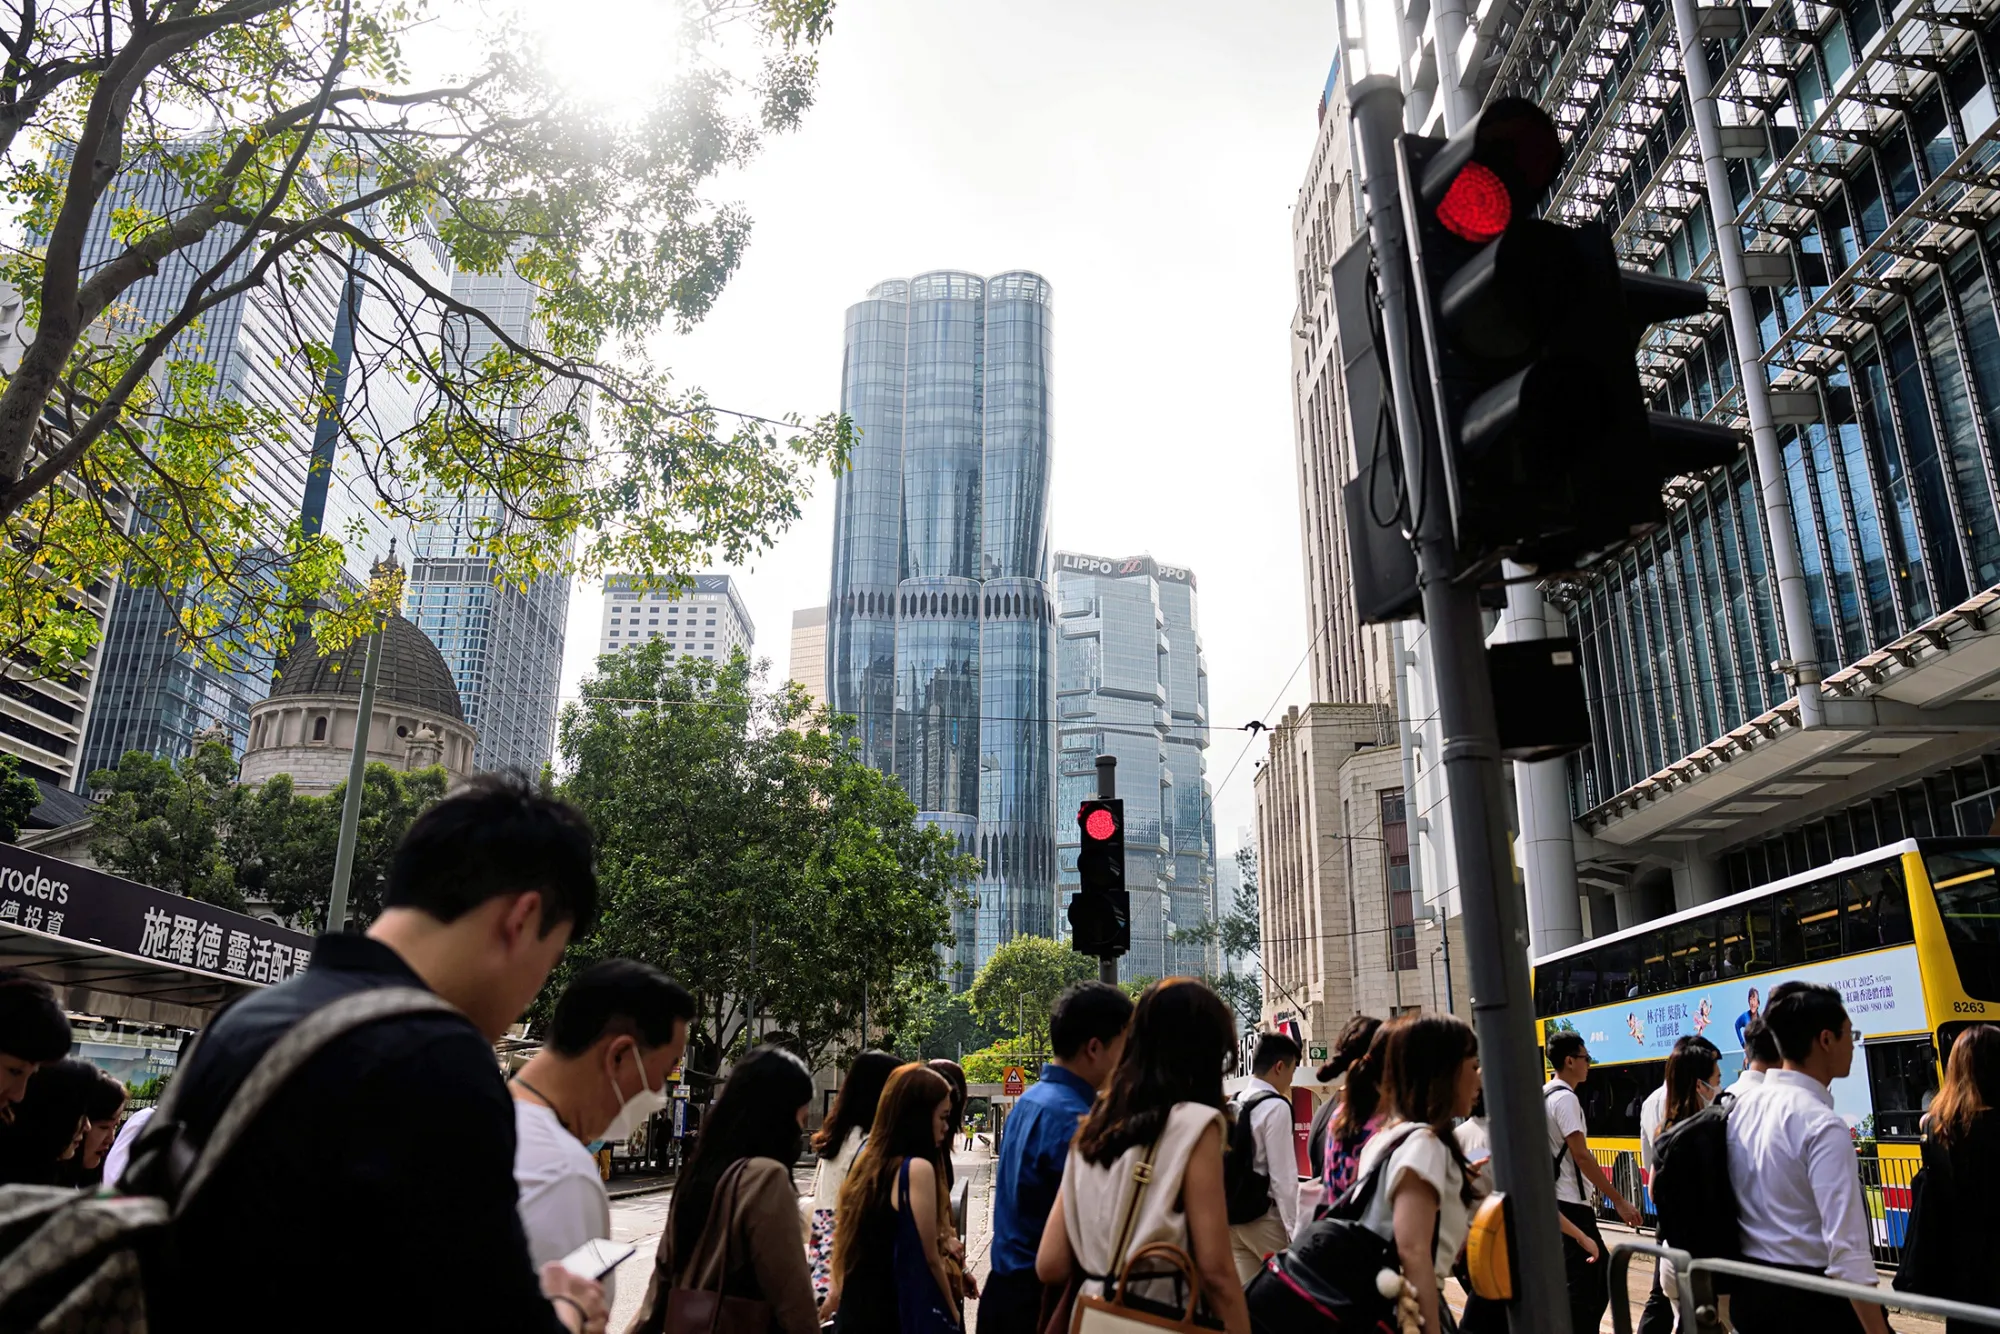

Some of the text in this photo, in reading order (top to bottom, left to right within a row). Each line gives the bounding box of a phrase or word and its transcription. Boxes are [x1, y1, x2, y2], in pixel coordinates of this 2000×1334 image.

[1063, 555, 1112, 574] LIPPO
[1158, 566, 1185, 580] PPO
[0, 866, 69, 904] roders
[139, 906, 223, 969] 施羅德
[1843, 978, 1857, 989] OCT
[1858, 975, 1874, 987] 2025
[1953, 1001, 1985, 1013] 8263
